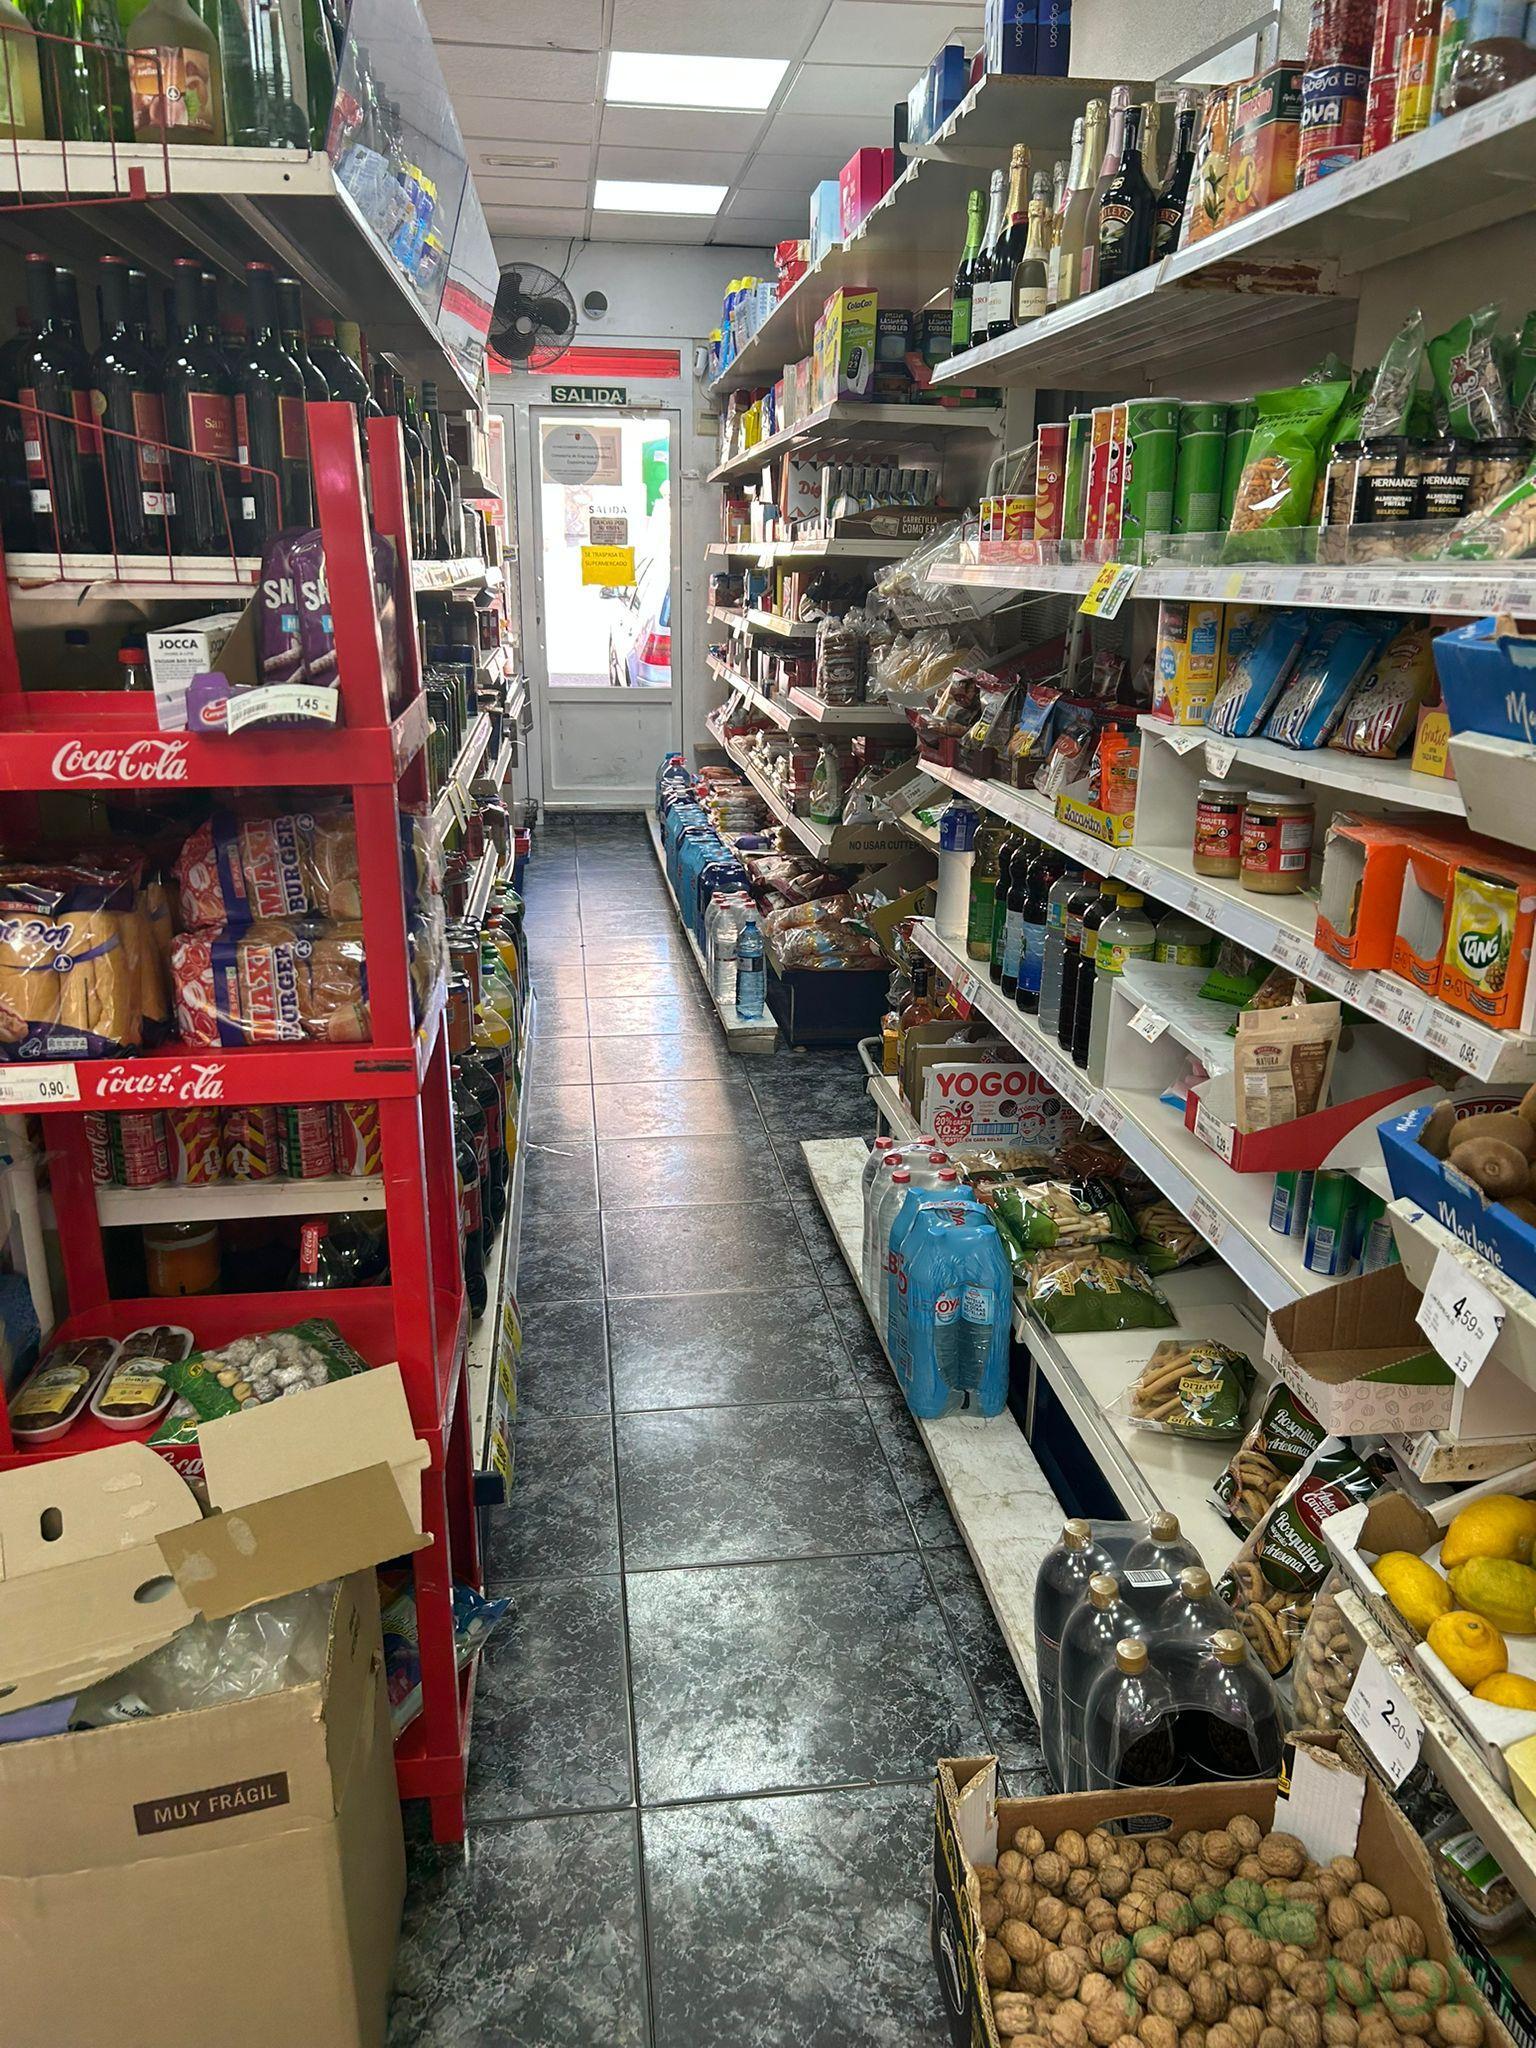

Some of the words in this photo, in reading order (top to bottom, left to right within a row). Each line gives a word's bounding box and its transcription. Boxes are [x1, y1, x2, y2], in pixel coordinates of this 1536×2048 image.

[1302, 101, 1339, 127] OYA
[1103, 206, 1131, 218] ILEYS
[554, 387, 625, 403] SALIDA
[799, 480, 822, 499] Dig
[588, 505, 628, 514] SALIDA
[902, 515, 938, 525] CARRETILLA
[158, 639, 199, 650] JOCCA
[296, 697, 319, 712] 1,45
[1421, 722, 1447, 747] Gratis
[52, 739, 190, 782] Coca-Cola
[1197, 816, 1227, 827] CAHUETE
[848, 840, 861, 850] NO
[863, 840, 886, 850] USAR
[887, 840, 920, 850] CUTTER
[244, 818, 287, 918] MAXI
[274, 815, 308, 915] BURGER
[1462, 935, 1499, 964] TANG
[1397, 1008, 1412, 1026] 0,95
[1459, 1043, 1476, 1063] 0,95
[39, 1080, 64, 1098] 0,90
[936, 1125, 967, 1136] 10+2
[1438, 1199, 1504, 1270] Marlene
[1454, 1355, 1468, 1373] 13
[1273, 1408, 1319, 1451] Rosquilla
[1267, 1437, 1311, 1458] Artesanas
[1275, 1510, 1325, 1574] Rosquillas
[1264, 1543, 1307, 1573] Artesanas
[153, 1800, 201, 1825] MUY
[208, 1783, 278, 1814] FRÁGIL
